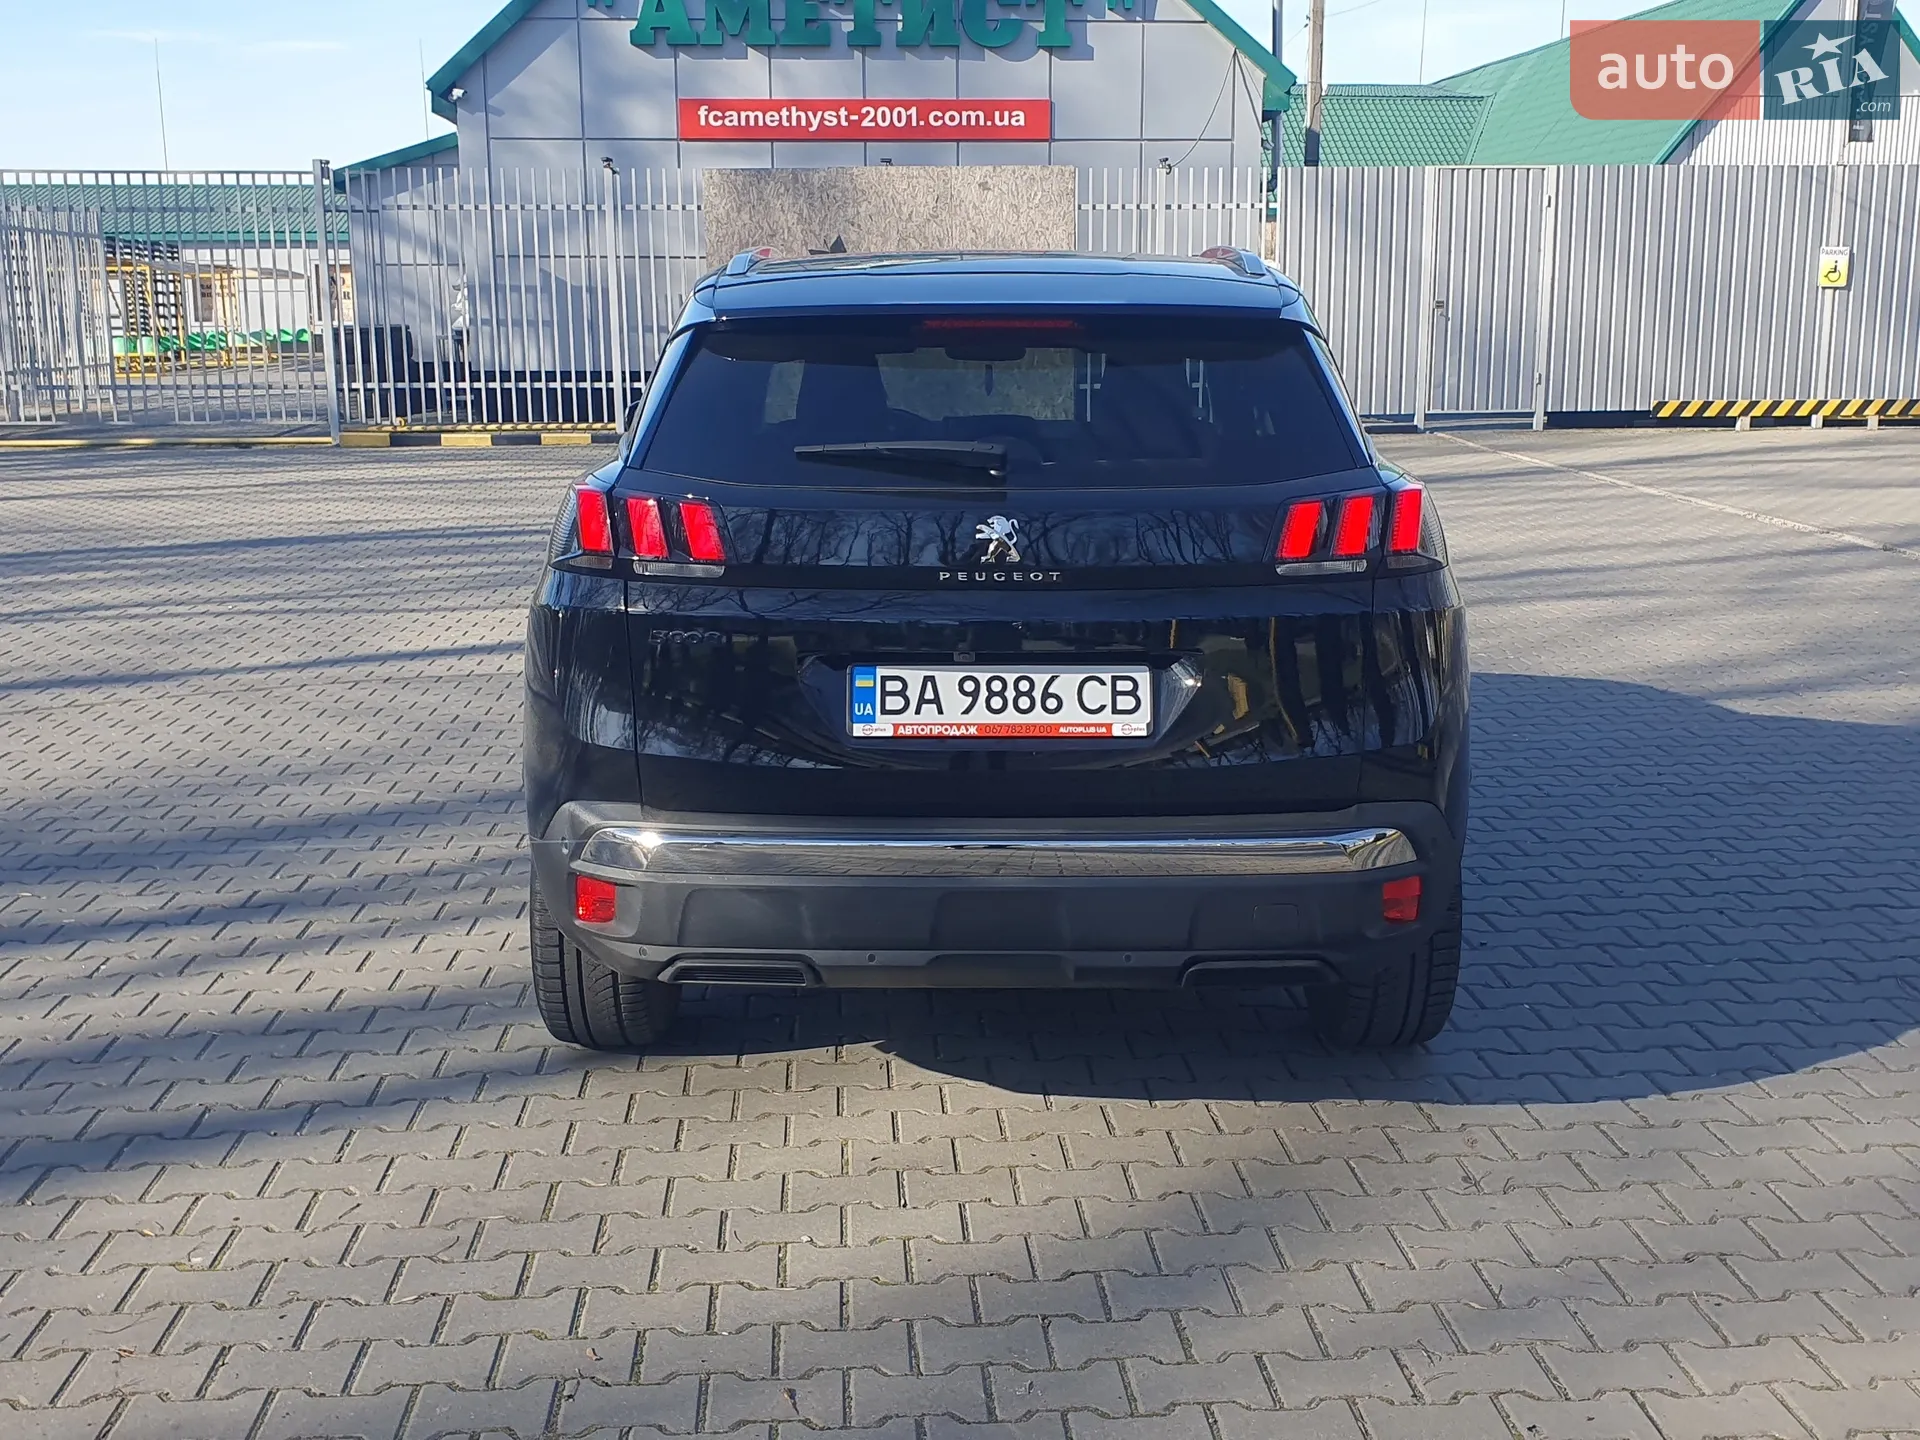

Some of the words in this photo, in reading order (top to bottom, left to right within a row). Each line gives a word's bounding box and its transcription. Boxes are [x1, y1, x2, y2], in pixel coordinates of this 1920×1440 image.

[698, 106, 1025, 132] fcamethyst-2001.com.ua
[1821, 248, 1848, 256] PARKING
[939, 572, 1061, 581] PEUGEOT
[880, 675, 944, 715] BA
[958, 675, 1063, 715] 9886
[1076, 675, 1142, 715] CB
[855, 703, 873, 716] UA
[897, 725, 978, 736] АВТОПРОДАЖ
